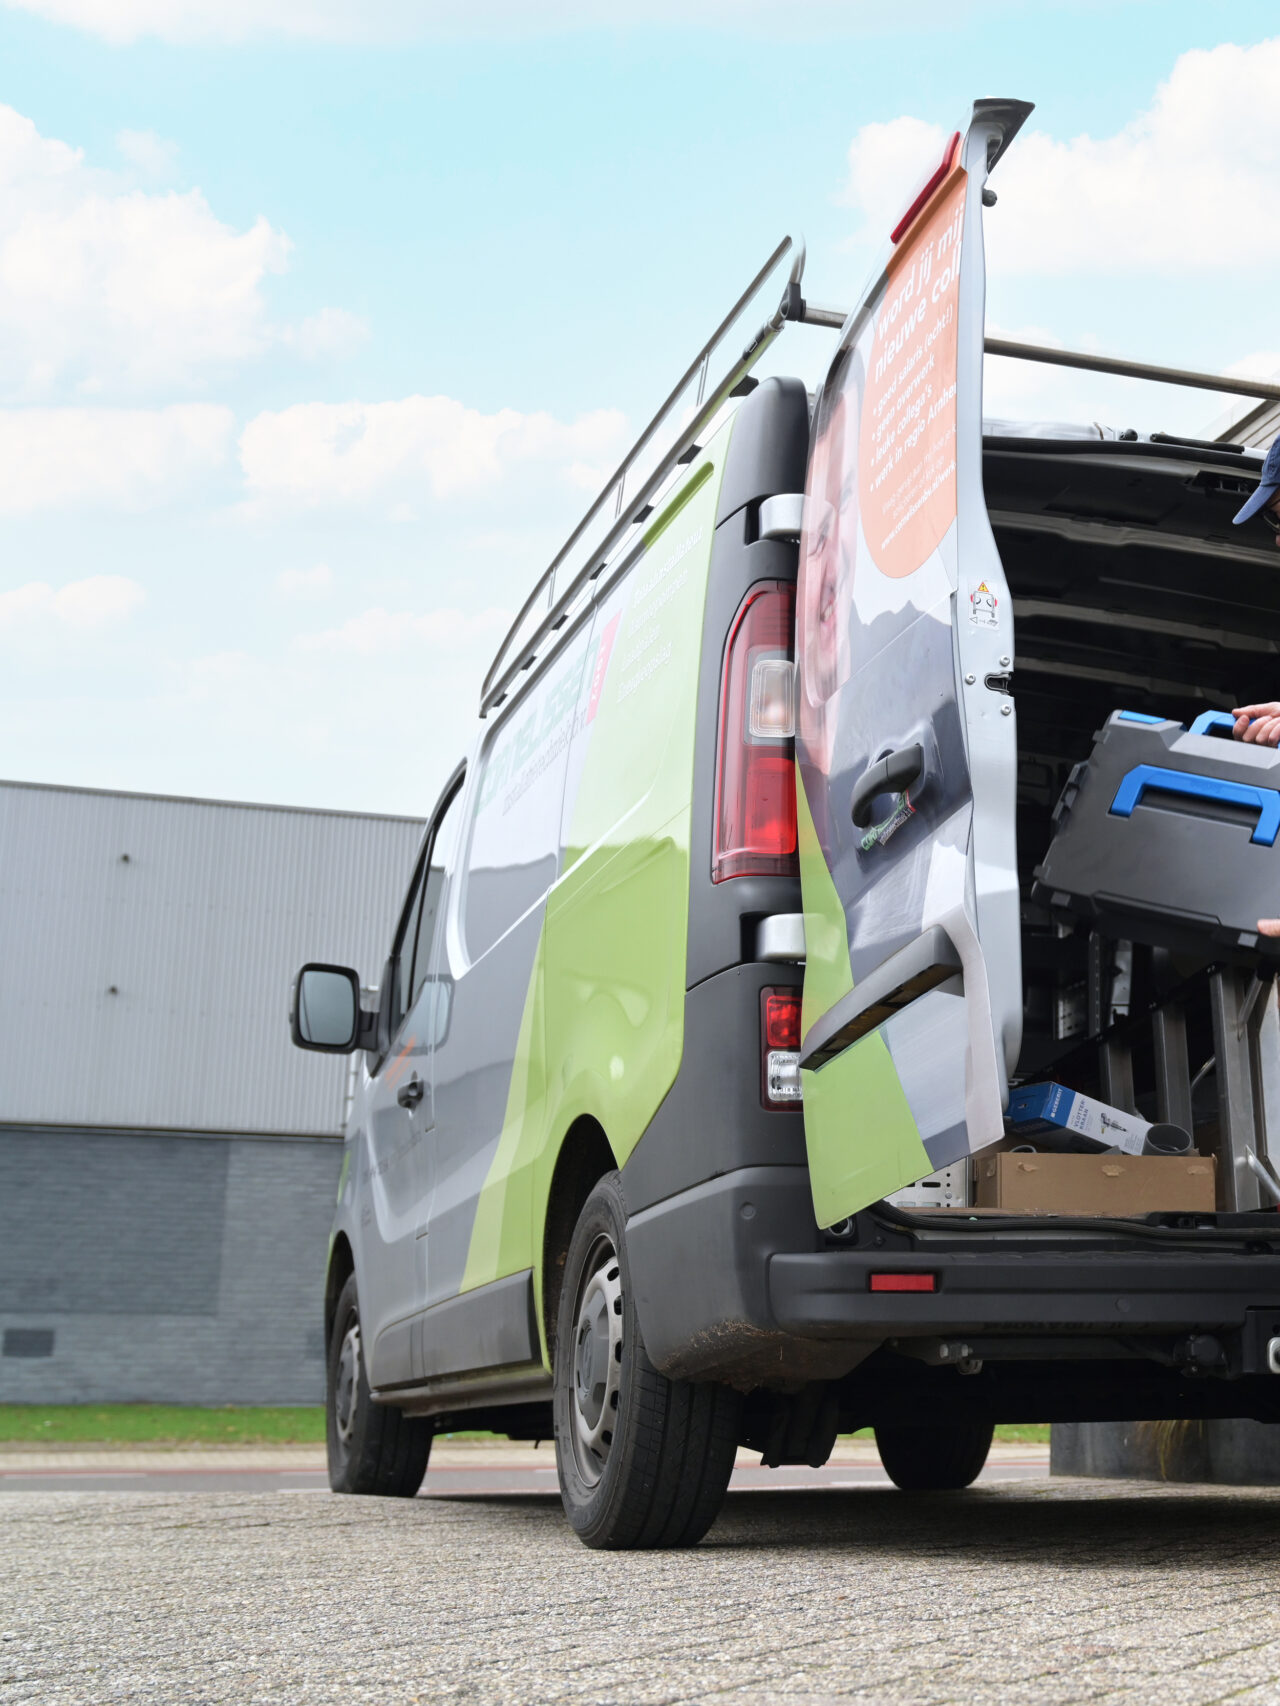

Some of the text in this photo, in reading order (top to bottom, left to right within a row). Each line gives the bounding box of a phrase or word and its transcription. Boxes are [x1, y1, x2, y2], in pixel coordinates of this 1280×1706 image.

[878, 263, 916, 341] word
[916, 241, 934, 296] jij
[874, 296, 927, 385] nieuwe
